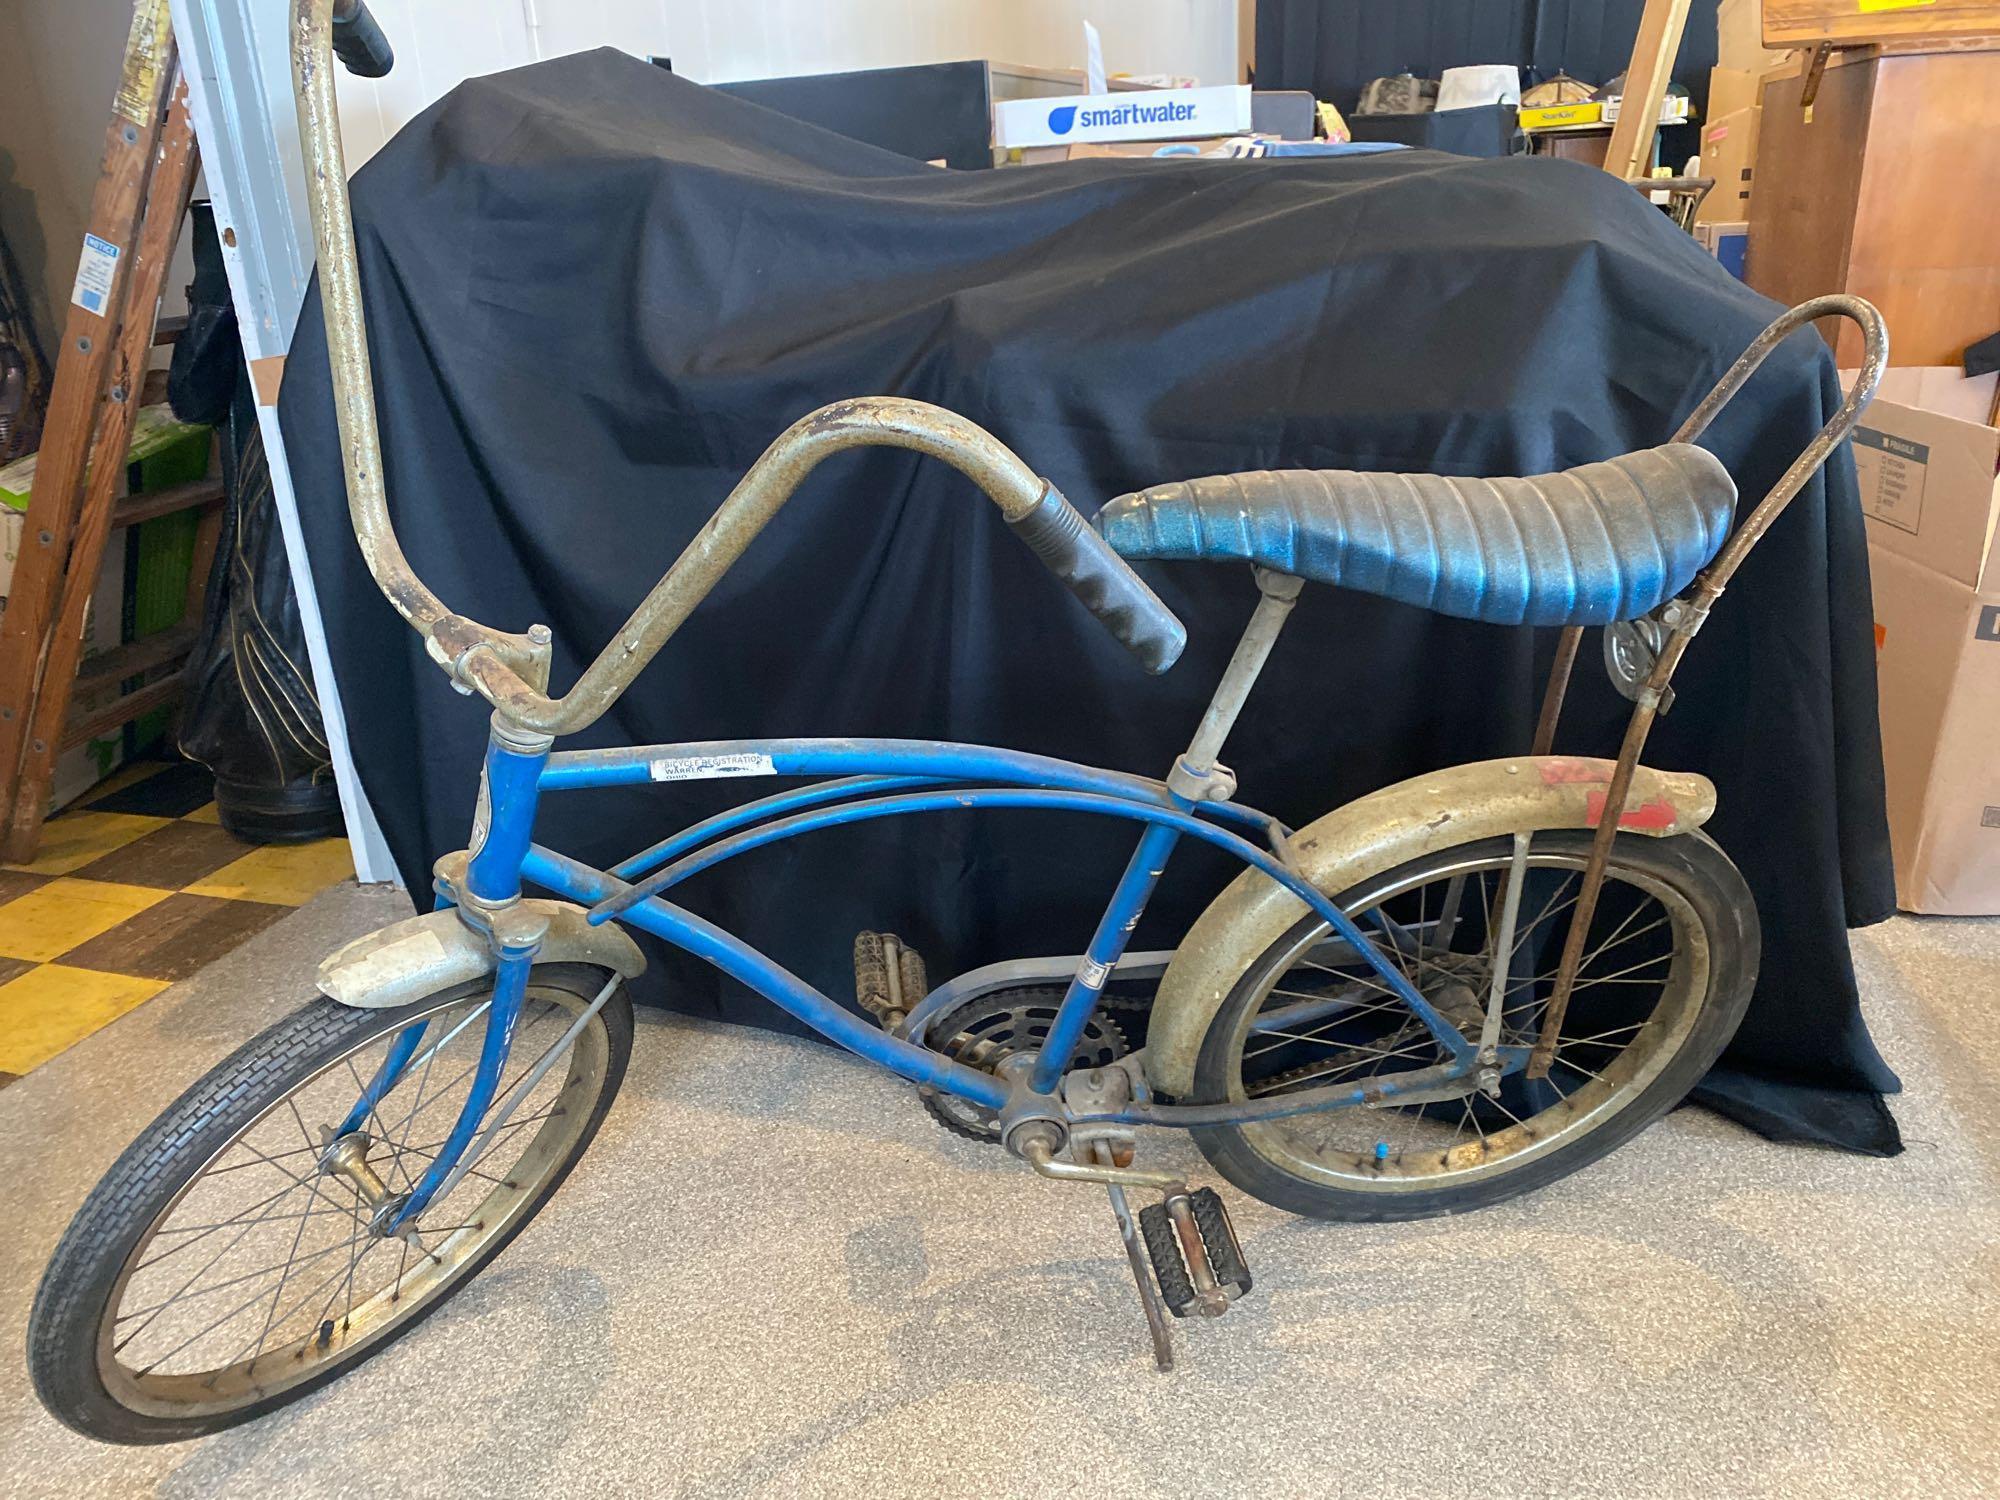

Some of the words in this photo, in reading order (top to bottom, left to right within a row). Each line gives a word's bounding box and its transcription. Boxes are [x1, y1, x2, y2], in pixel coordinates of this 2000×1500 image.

[1081, 101, 1196, 127] smartwater
[88, 238, 116, 255] NOTICE
[1889, 440, 1915, 455] FRAGILE
[664, 758, 699, 768] BICYCLE
